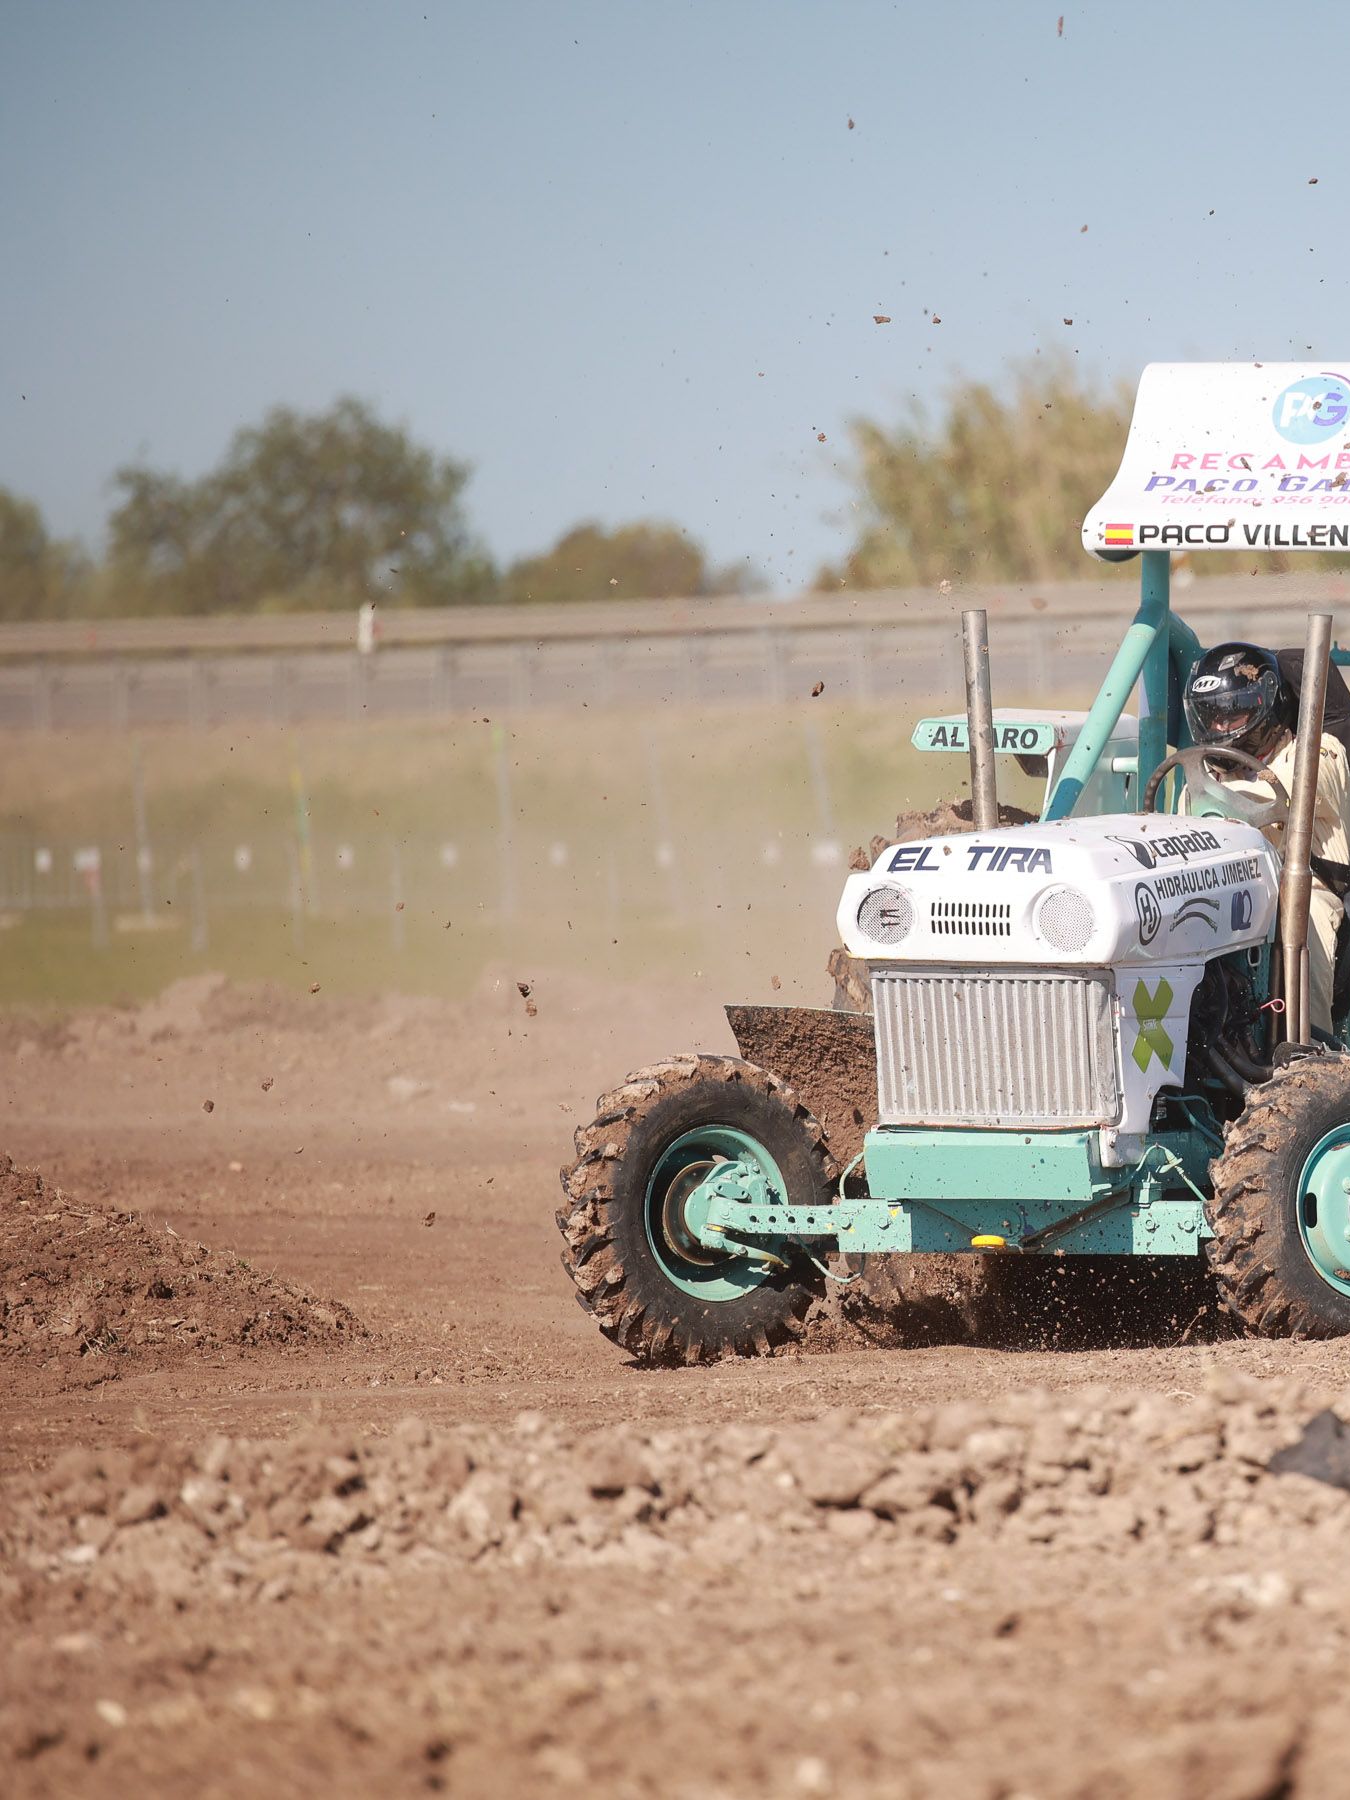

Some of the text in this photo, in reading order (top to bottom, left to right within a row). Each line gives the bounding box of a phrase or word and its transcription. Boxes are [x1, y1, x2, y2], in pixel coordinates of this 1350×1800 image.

[1144, 475, 1259, 492] PACO
[1139, 524, 1230, 544] PACO
[930, 725, 1039, 749] ALRO
[887, 846, 1053, 874] EL TIRA
[1154, 857, 1261, 900] HIDRÁULICA JIMENEZ
